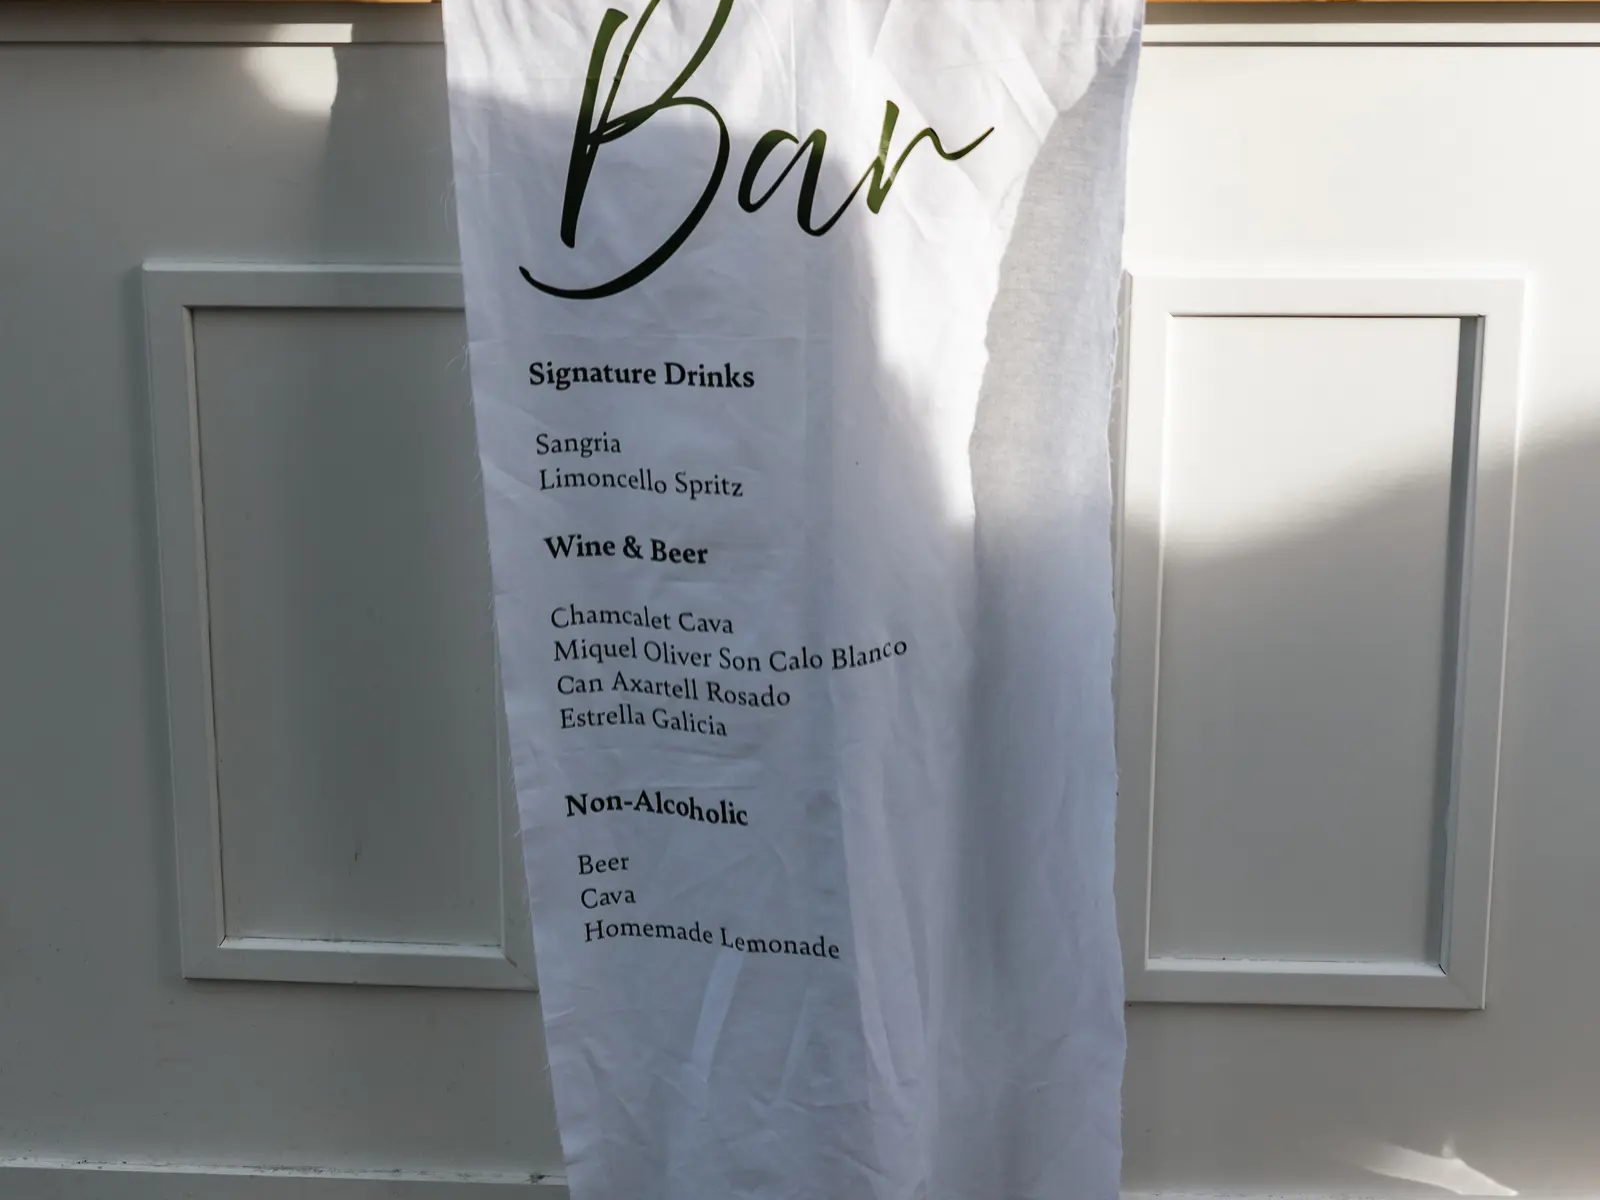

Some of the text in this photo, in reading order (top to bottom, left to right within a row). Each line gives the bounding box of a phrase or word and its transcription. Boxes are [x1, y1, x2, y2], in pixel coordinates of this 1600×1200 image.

[529, 361, 755, 391] Signature Drinks
[535, 432, 621, 458] Sangria
[539, 467, 743, 501] Limoncello Spritz
[543, 534, 708, 564] Wine & Beer
[551, 604, 733, 634] Chamcalet Cava
[553, 637, 908, 672] Miquel Oliver Son Calo Blanco
[557, 671, 791, 707] Can Axartell Rosado
[560, 704, 727, 736] Estrella Galicia
[565, 790, 749, 826] Non-Alcoholic
[578, 853, 629, 875] Beer
[581, 887, 636, 909] Cava
[585, 920, 840, 960] Homemade Lemonade
